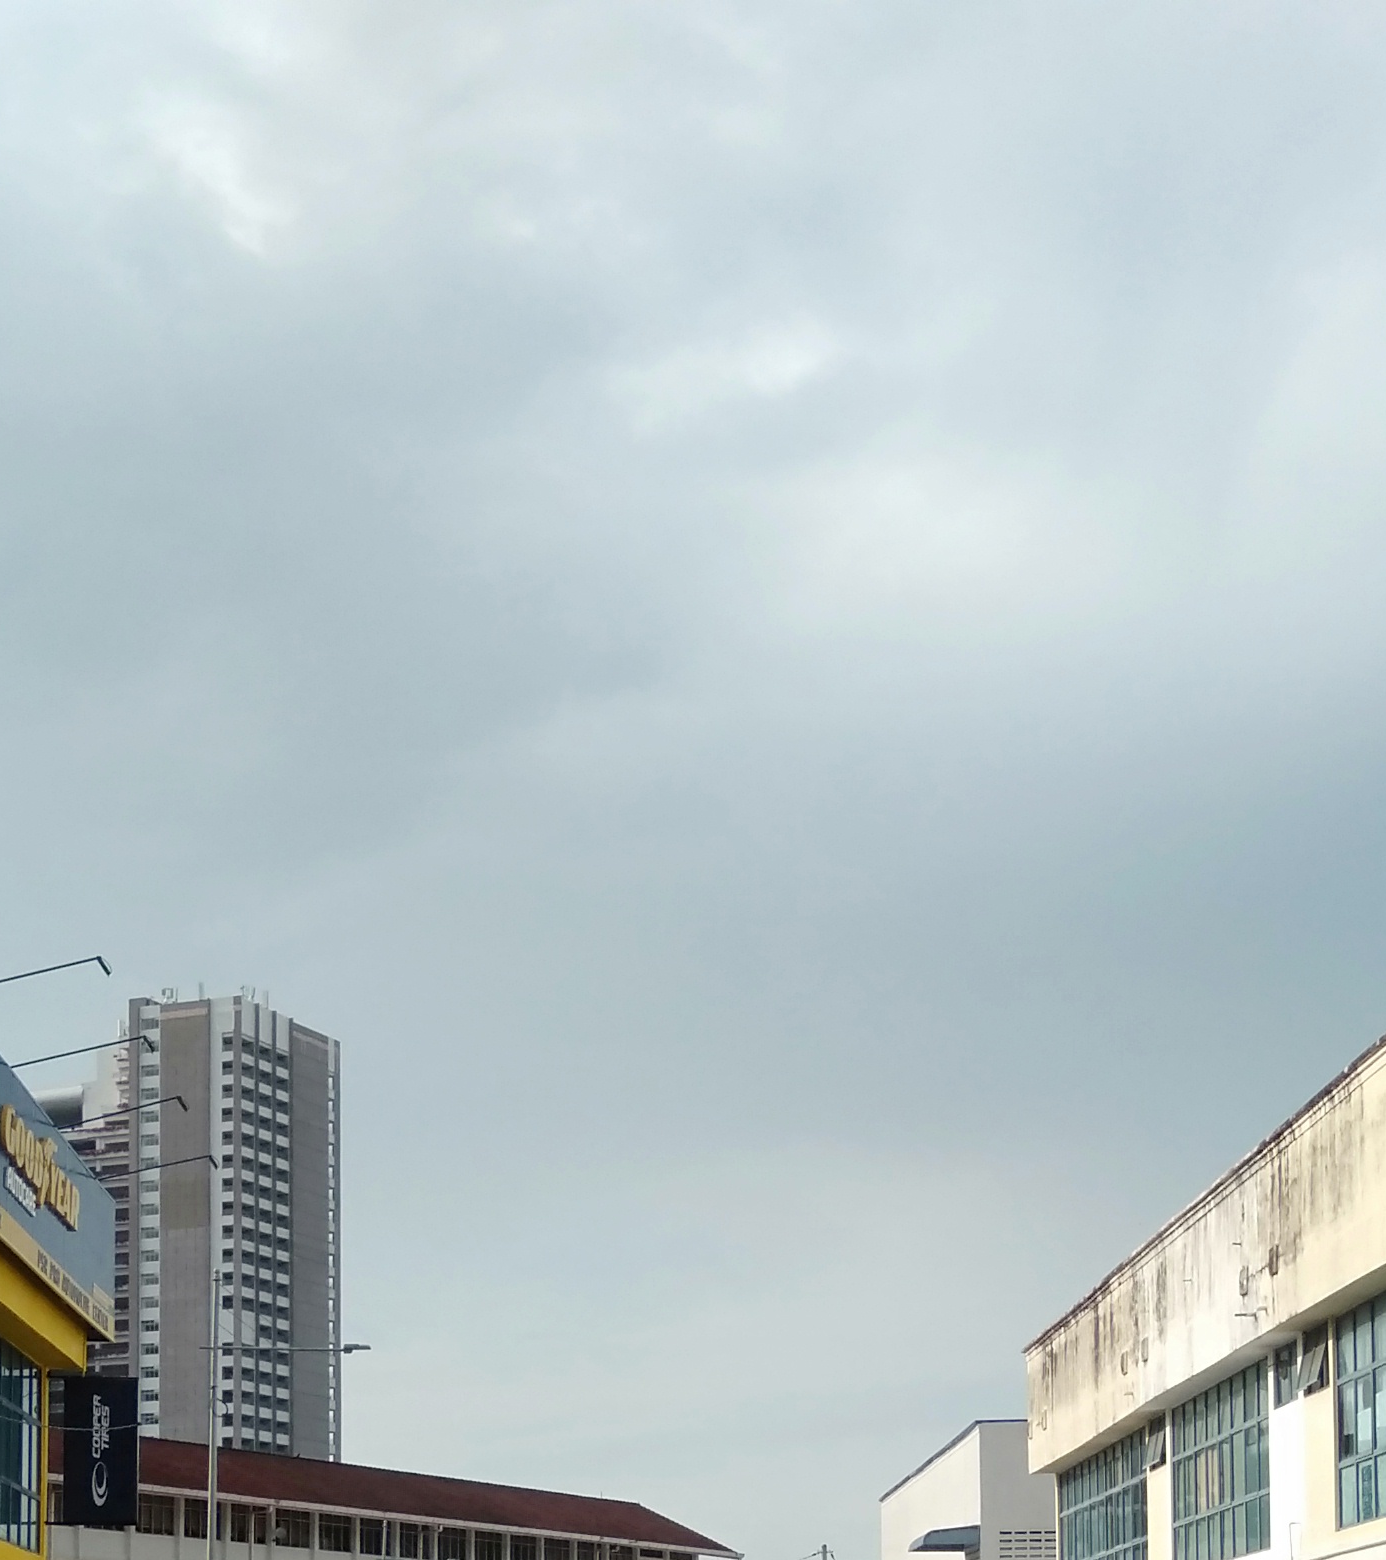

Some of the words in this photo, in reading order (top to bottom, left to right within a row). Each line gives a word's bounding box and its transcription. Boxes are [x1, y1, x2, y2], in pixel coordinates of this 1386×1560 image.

[0, 1104, 79, 1232] GOODYEAR
[92, 1394, 101, 1459] COOPER
[101, 1405, 110, 1450] TIRES
